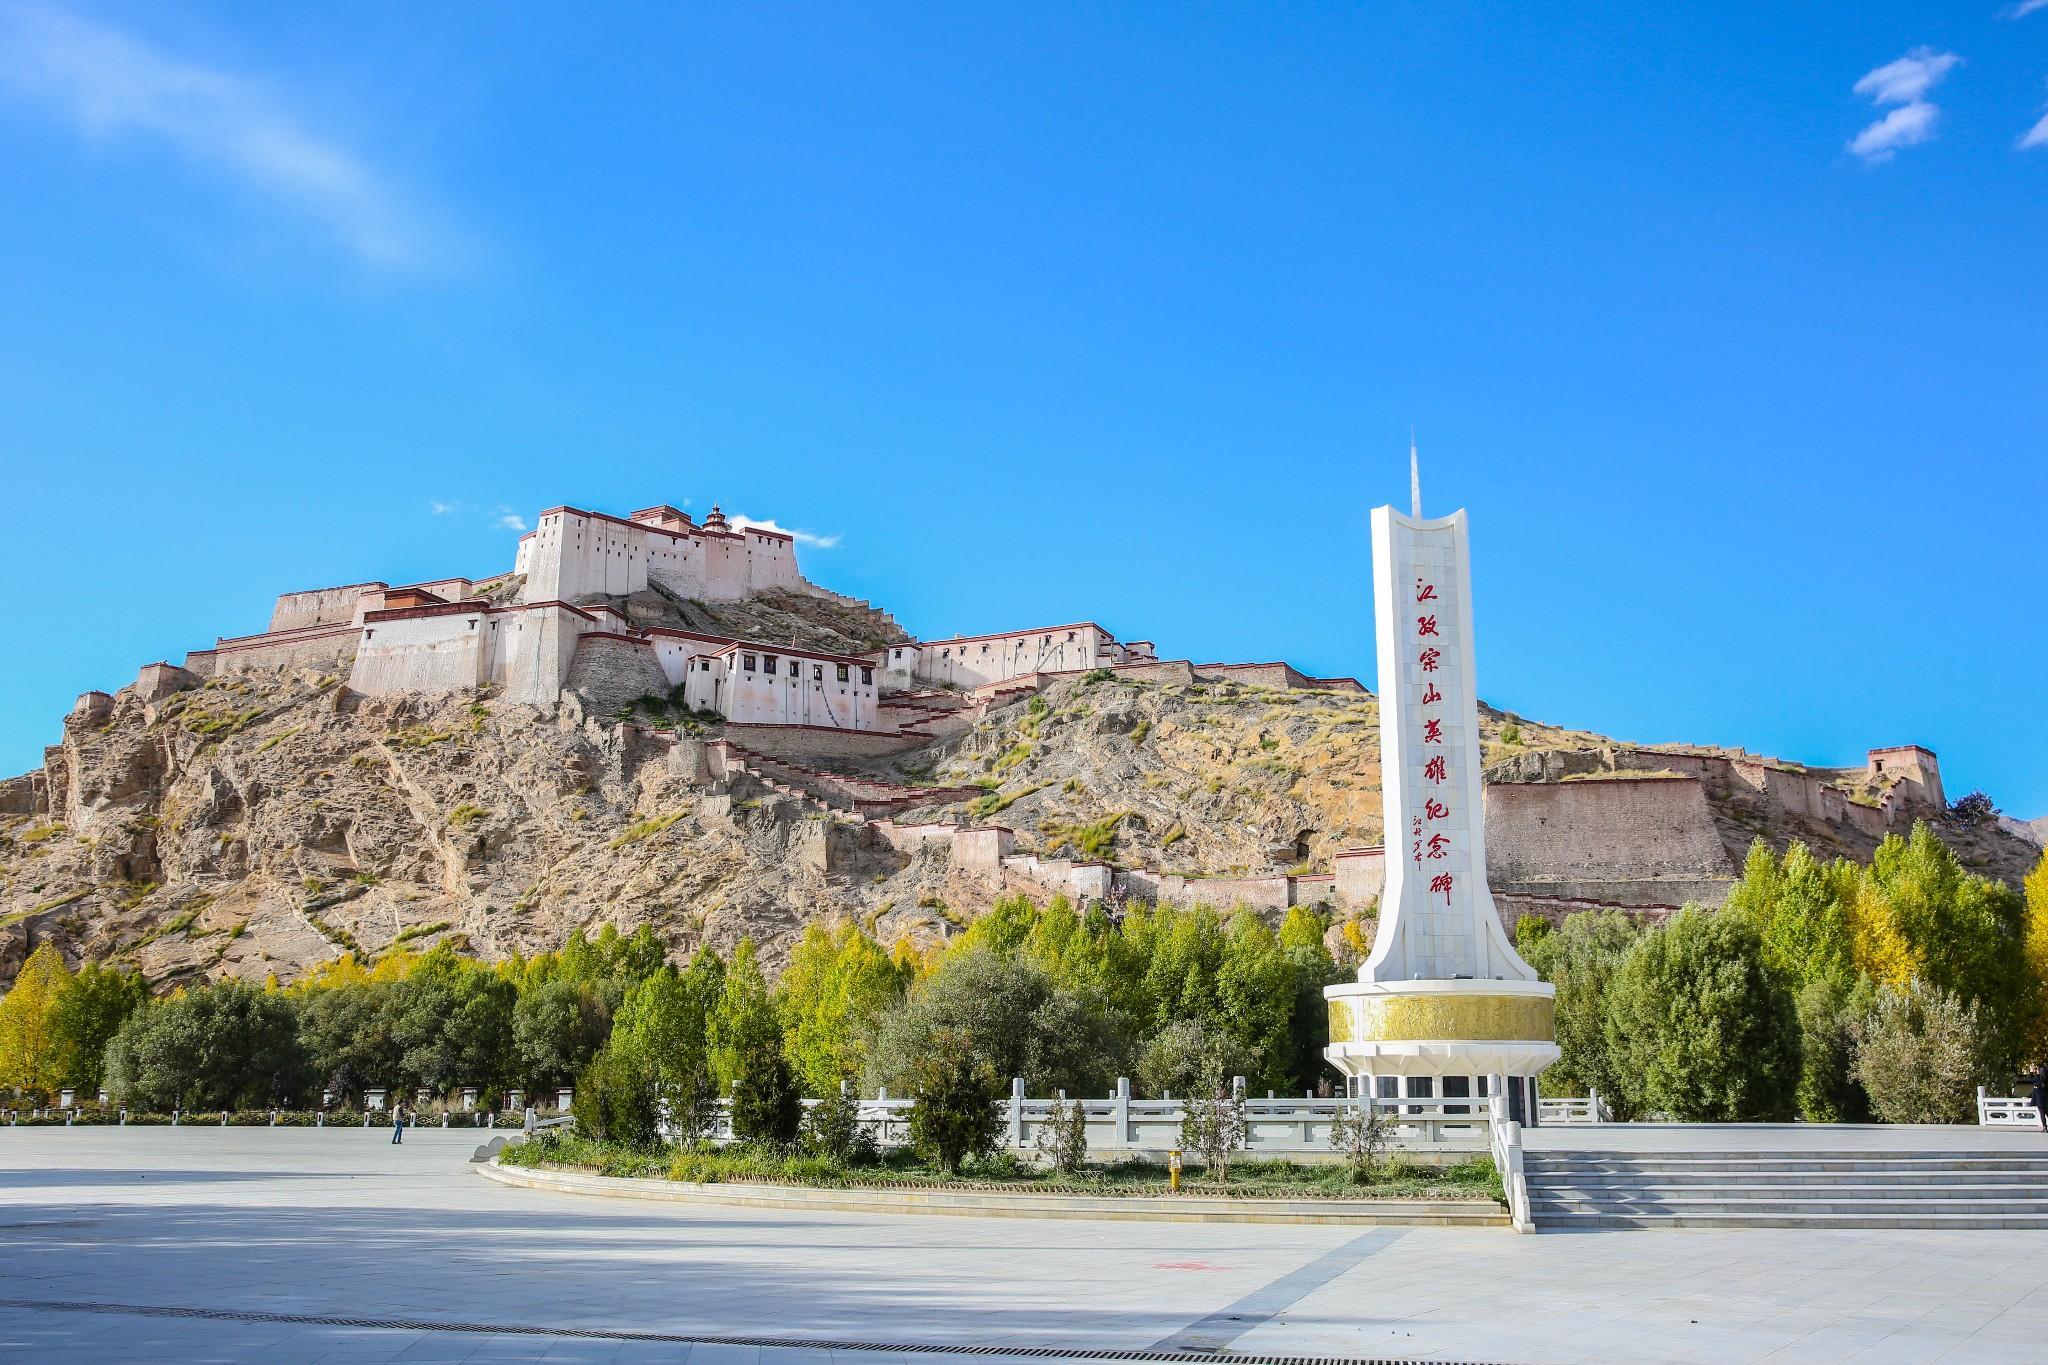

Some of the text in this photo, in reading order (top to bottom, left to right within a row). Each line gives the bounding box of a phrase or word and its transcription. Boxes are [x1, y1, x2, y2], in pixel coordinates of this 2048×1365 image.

[1416, 577, 1453, 906] 江孜宗山英雄纪念碑
